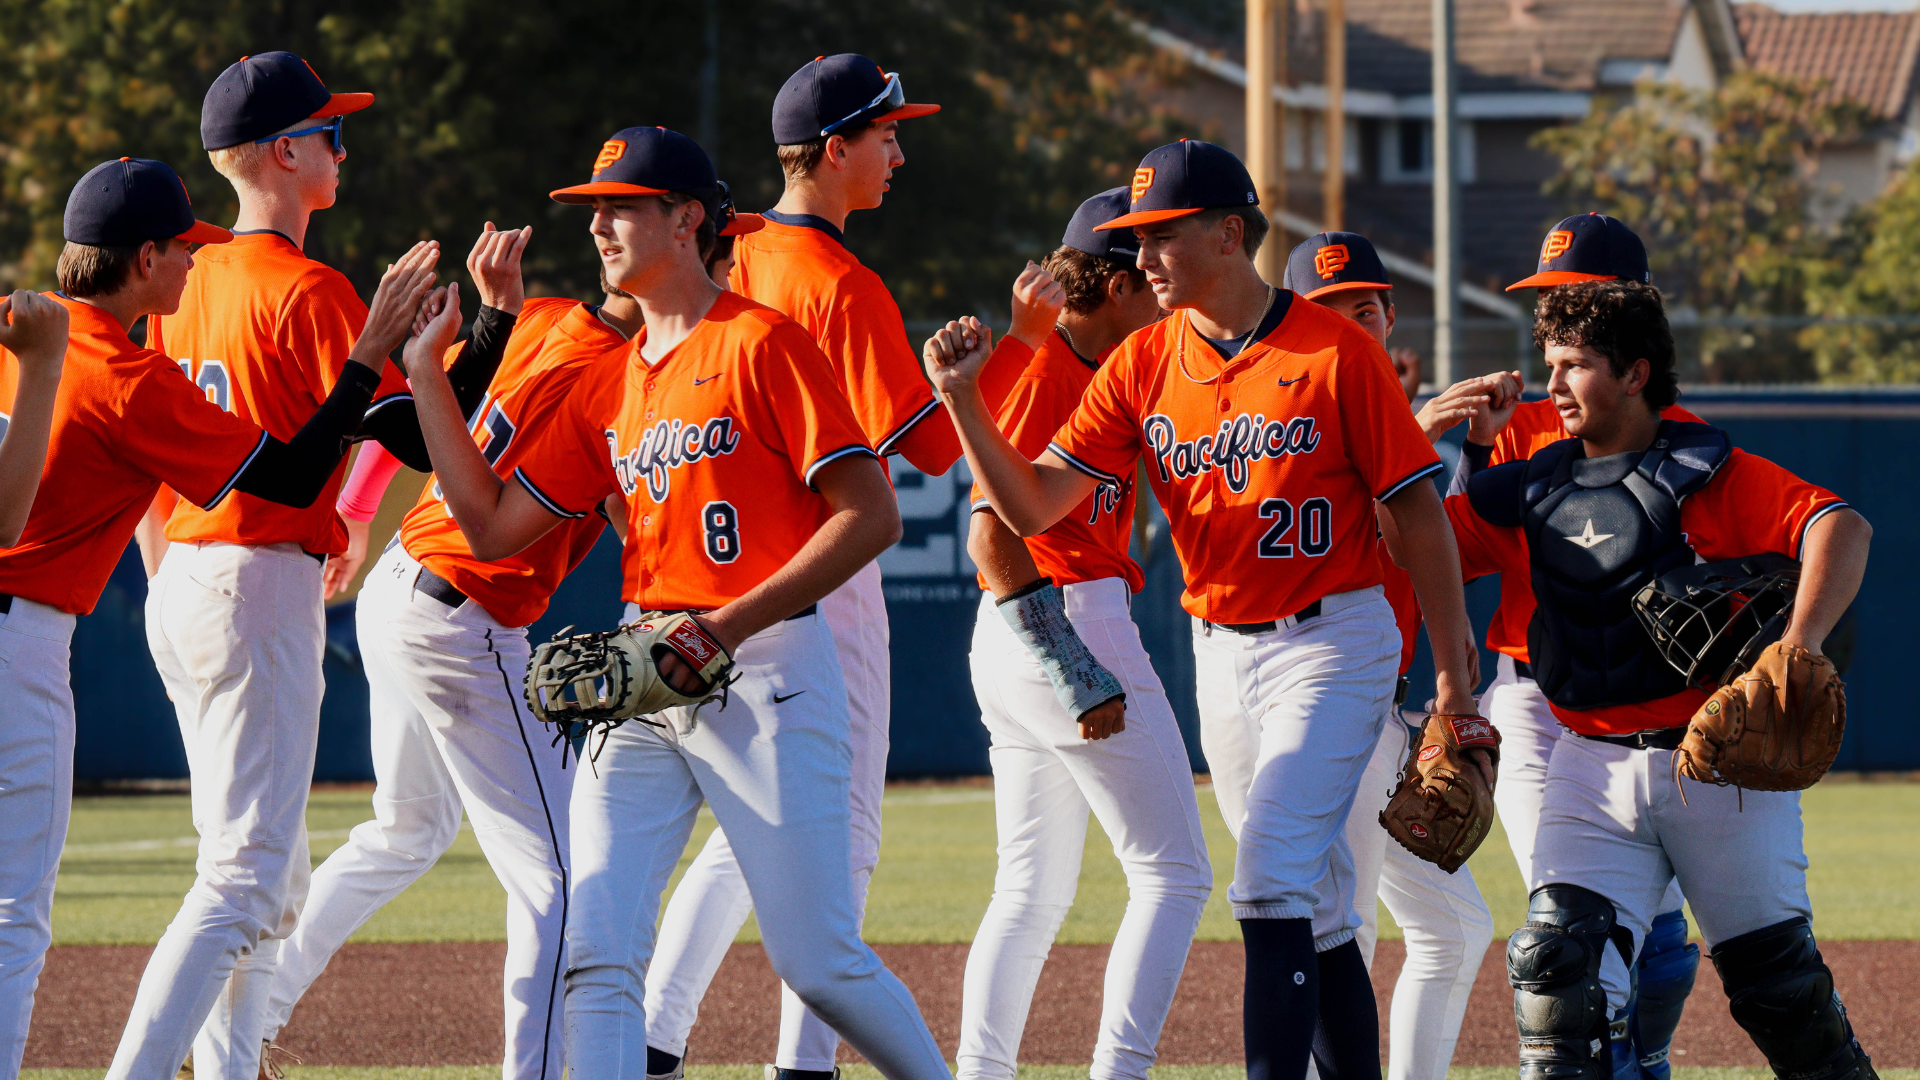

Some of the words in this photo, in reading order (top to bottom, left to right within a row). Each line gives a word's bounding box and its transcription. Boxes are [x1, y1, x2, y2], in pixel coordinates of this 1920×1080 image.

[605, 417, 740, 503] Paifica
[1143, 413, 1321, 493] Pacifica
[701, 500, 742, 564] 8
[1258, 497, 1332, 558] 20
